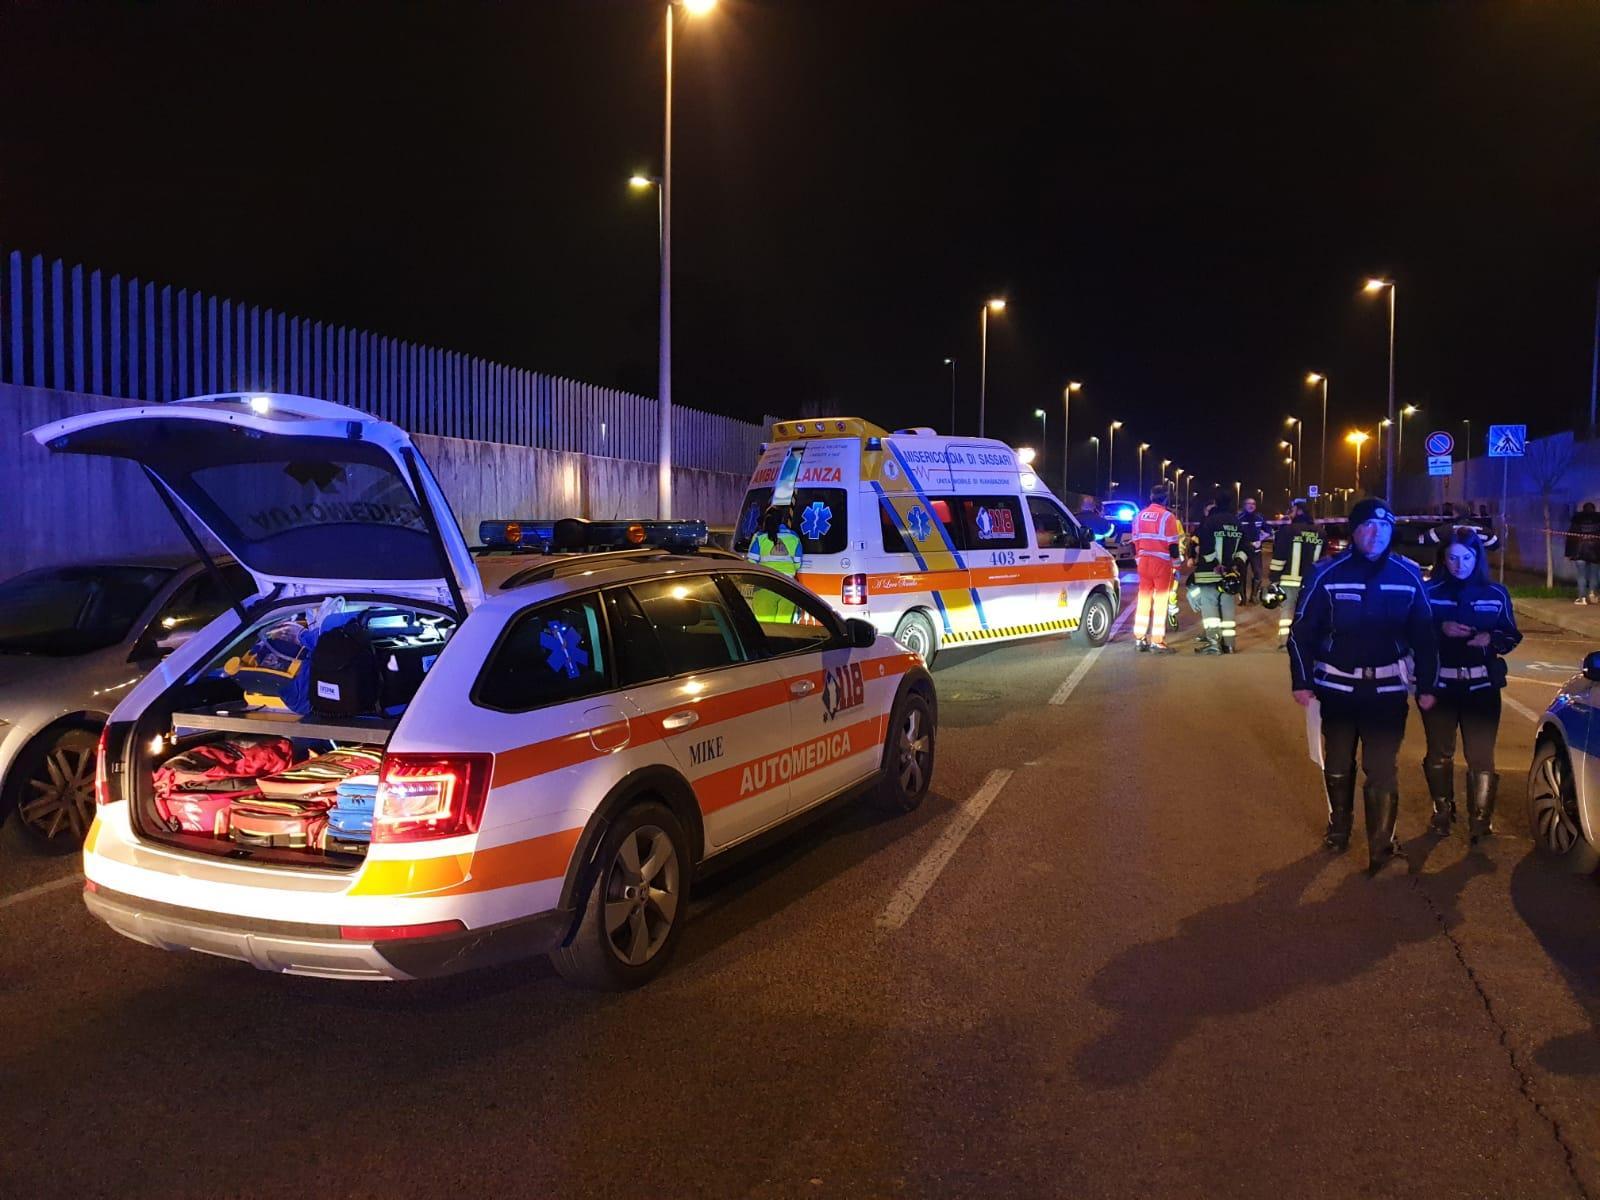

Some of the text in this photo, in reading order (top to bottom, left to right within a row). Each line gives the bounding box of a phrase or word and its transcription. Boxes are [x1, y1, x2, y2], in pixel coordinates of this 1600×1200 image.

[966, 453, 975, 464] DI
[979, 454, 1012, 466] SASSARI
[987, 508, 1015, 533] 118
[989, 551, 1015, 565] 403
[836, 662, 864, 712] 118
[688, 735, 724, 768] MIKE
[740, 731, 851, 796] AUTOMEDICA
